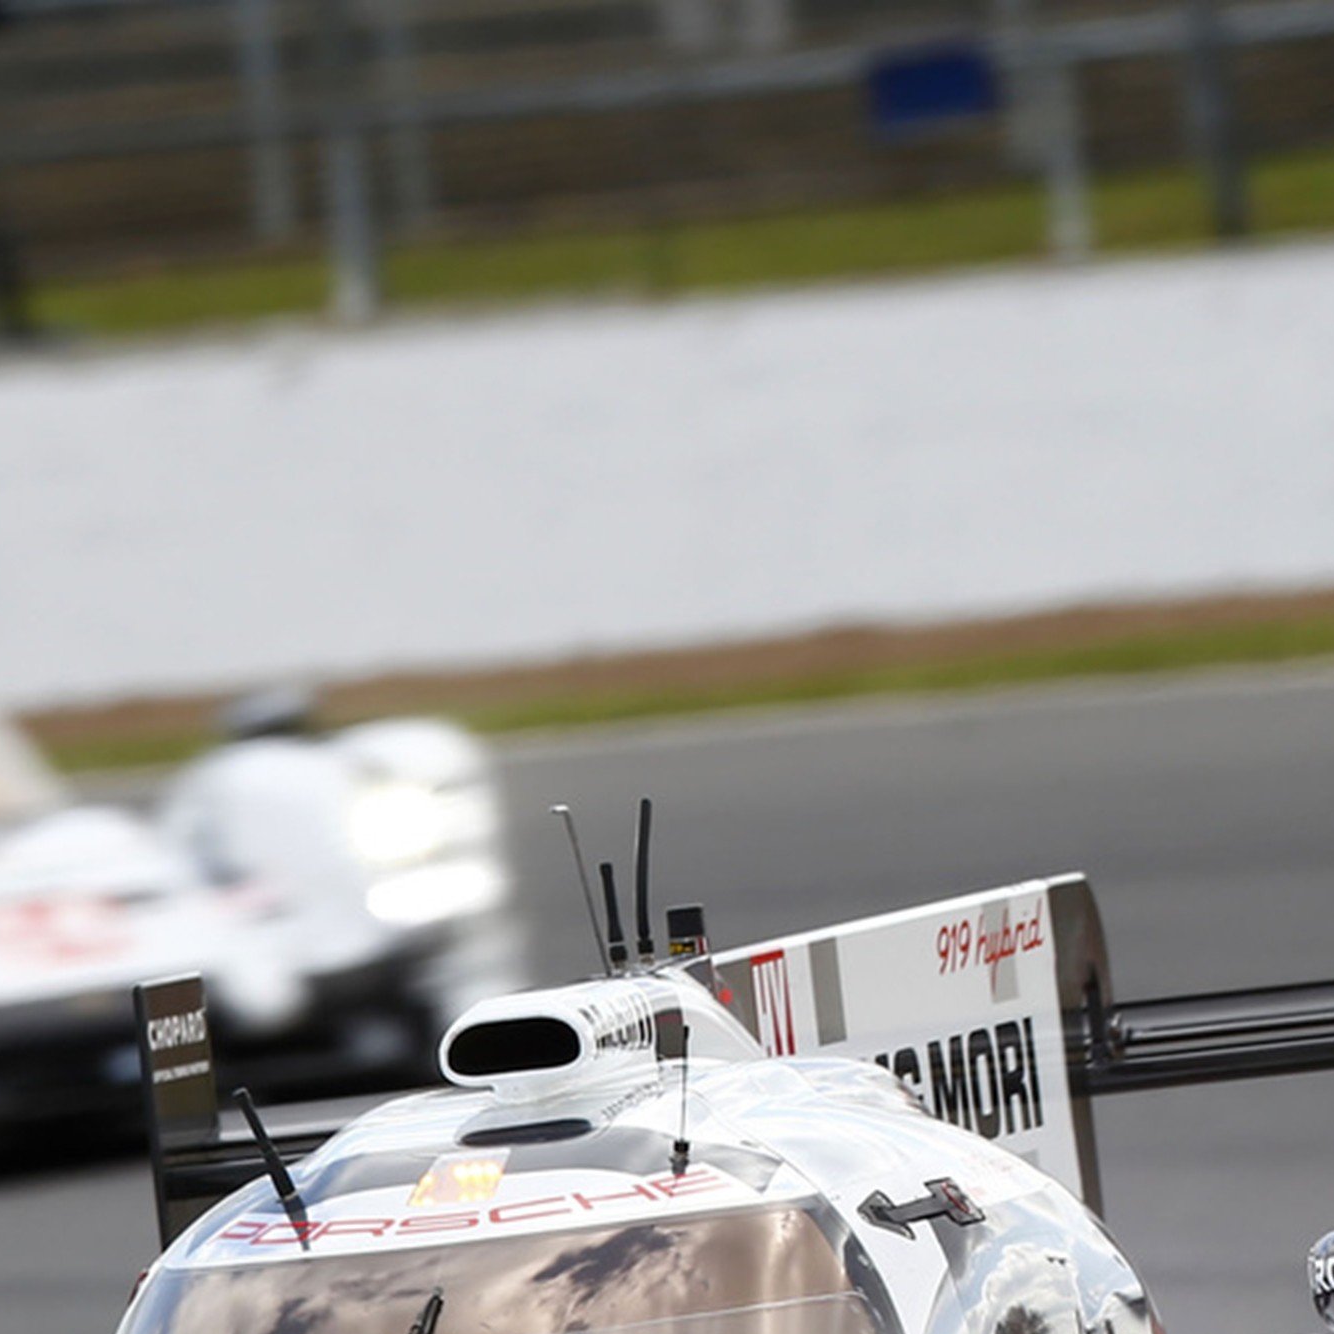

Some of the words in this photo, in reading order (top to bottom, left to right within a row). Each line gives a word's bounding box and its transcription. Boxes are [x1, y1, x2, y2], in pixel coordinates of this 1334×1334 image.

[936, 919, 972, 975] 919
[927, 1016, 1044, 1141] MORI
[207, 1168, 729, 1246] PORSCHE
